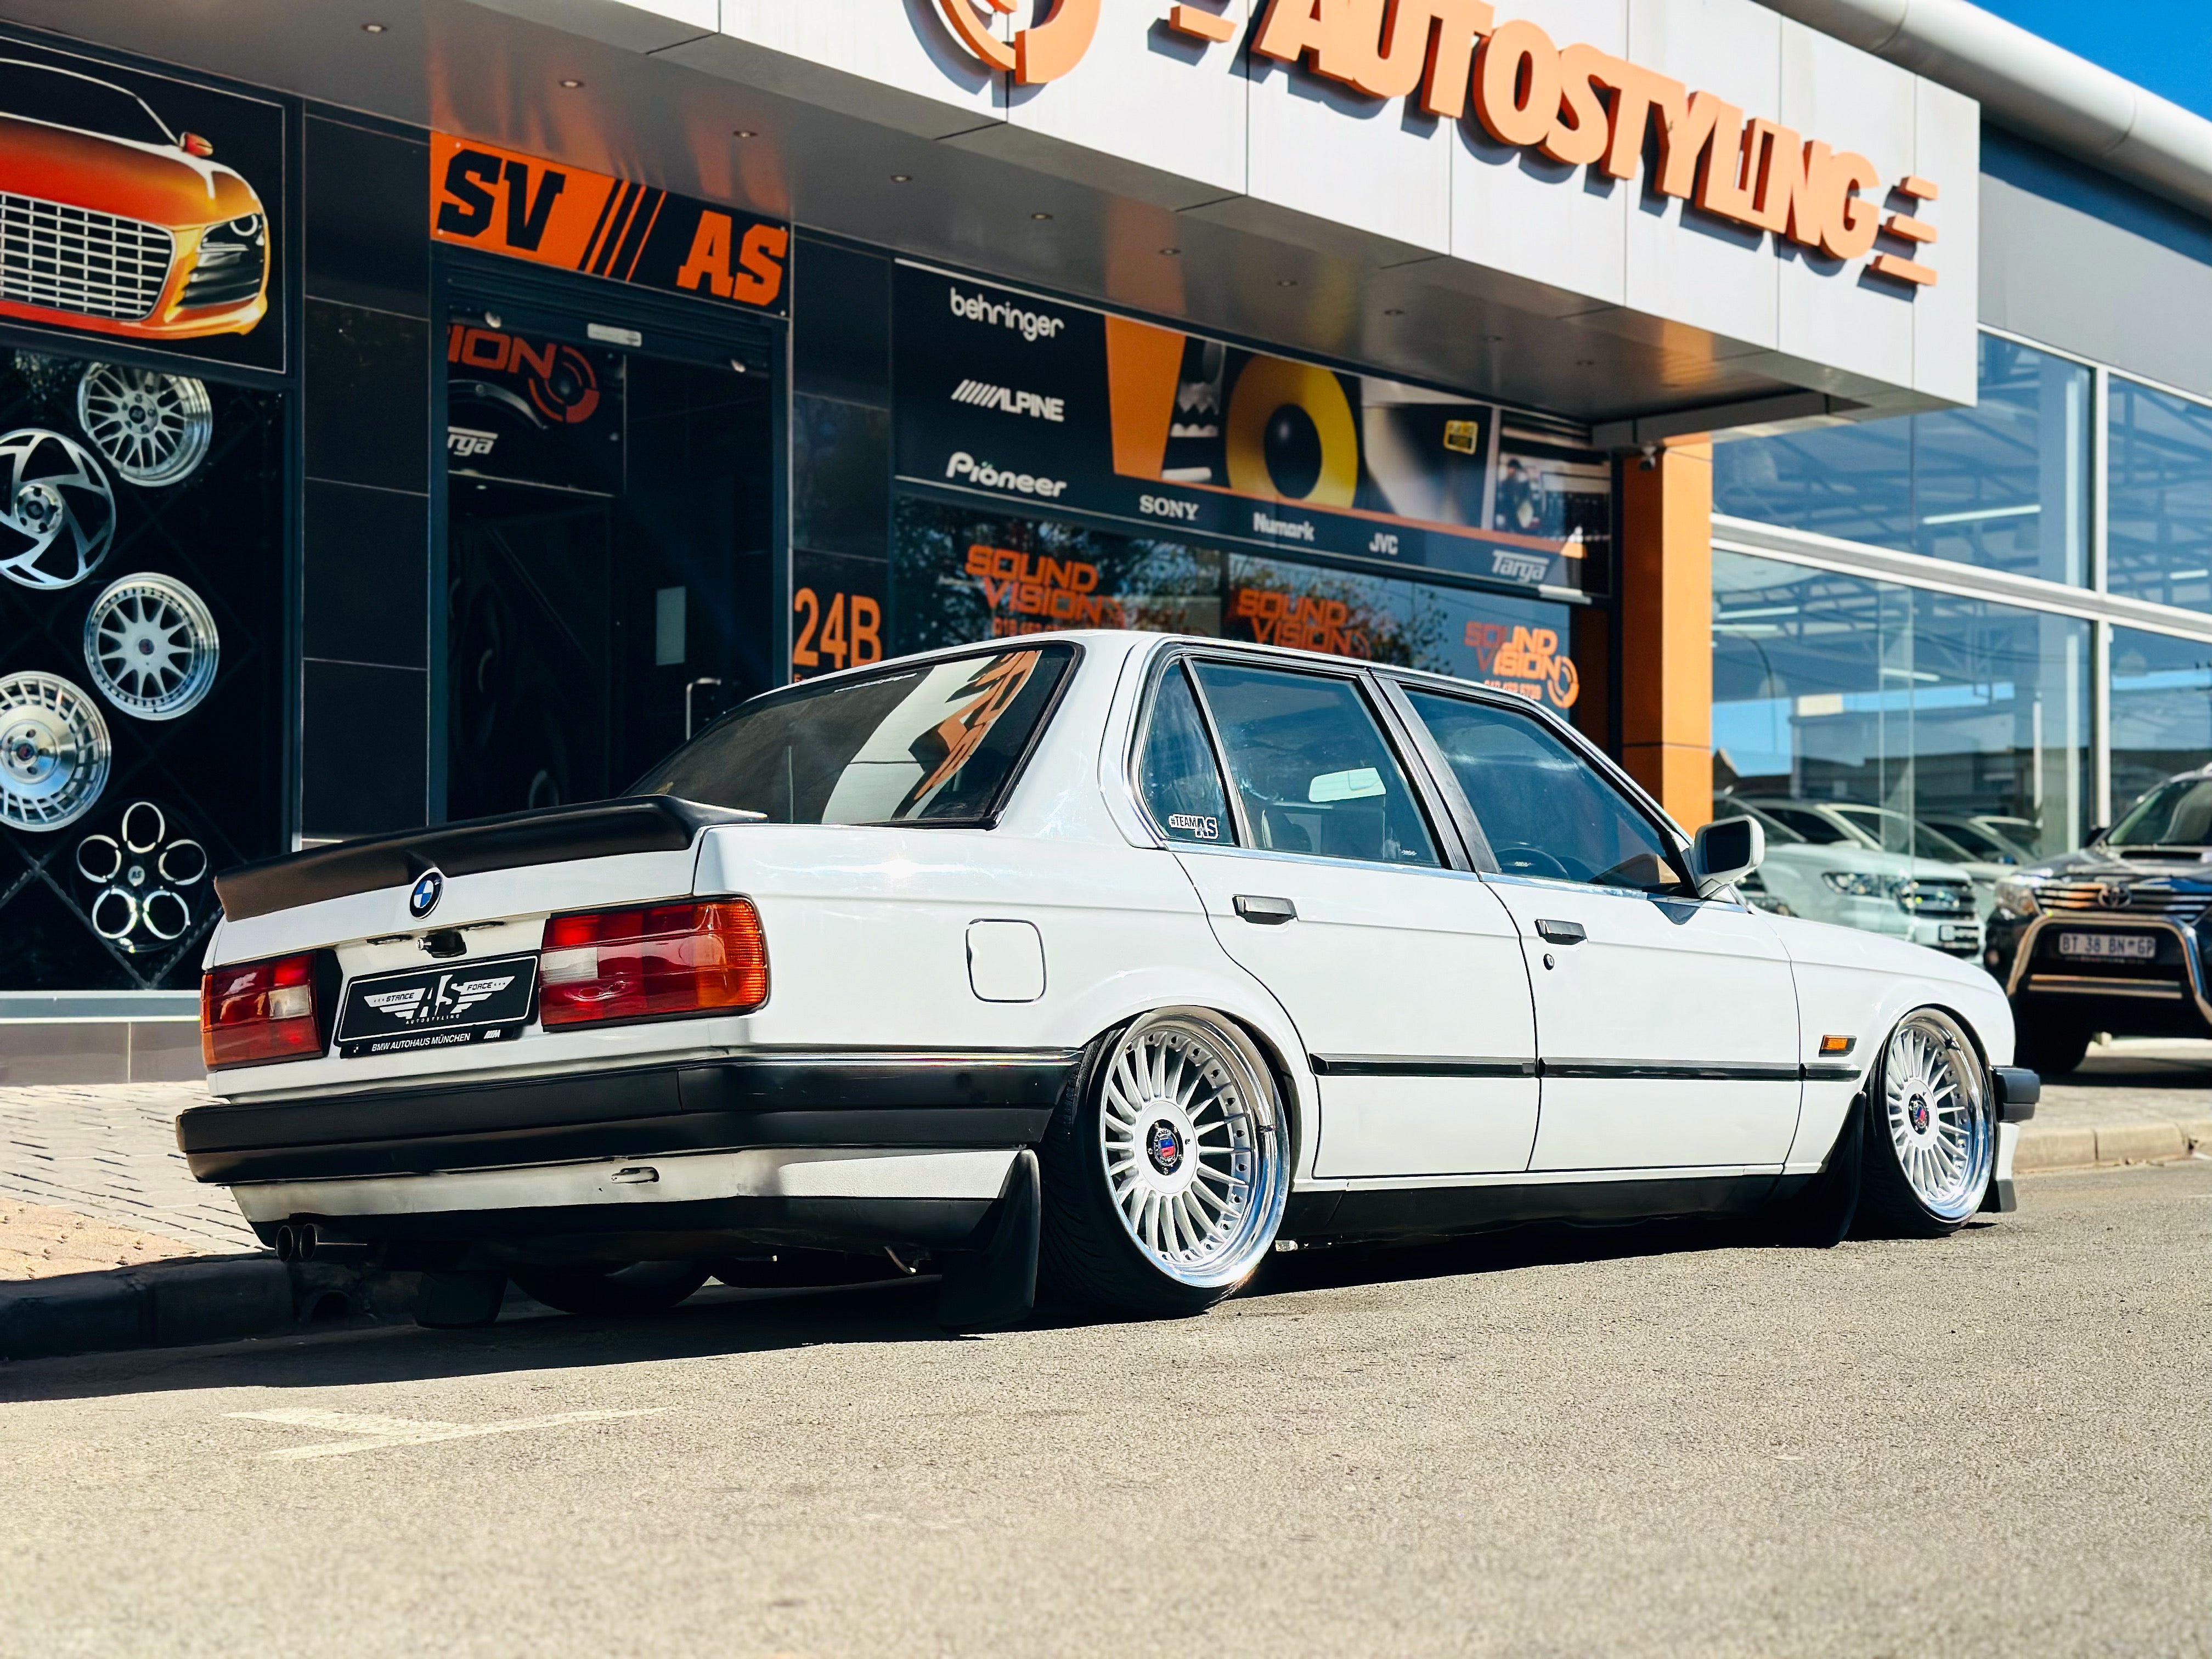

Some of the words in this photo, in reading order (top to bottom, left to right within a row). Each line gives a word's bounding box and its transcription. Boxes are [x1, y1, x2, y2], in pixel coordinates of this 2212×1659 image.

[1251, 0, 1881, 260] AUTOSTYLING
[437, 149, 566, 252] SV
[676, 210, 788, 306] AS
[950, 287, 1064, 341] behringer
[447, 324, 557, 380] ION
[984, 385, 1064, 422] ALPINE
[945, 452, 1066, 497] Pioneer
[1139, 495, 1199, 521] SONY
[1253, 512, 1314, 541] Numark
[1369, 533, 1398, 555] JVC
[965, 544, 1097, 592] SOUND
[1492, 549, 1550, 583] Targa
[982, 576, 1103, 629] VISION
[1238, 587, 1348, 628] SOUND
[793, 588, 882, 669] 24B
[1251, 617, 1356, 657] VISION
[1463, 620, 1559, 656] SOUND
[1476, 646, 1562, 684] VISION
[467, 981, 493, 991] FORCE
[405, 1014, 460, 1025] AUTOSTYLING
[371, 1042, 391, 1052] BMW
[390, 1037, 430, 1050] AUTOHAUS
[431, 1032, 471, 1045] MÜNCHEN
